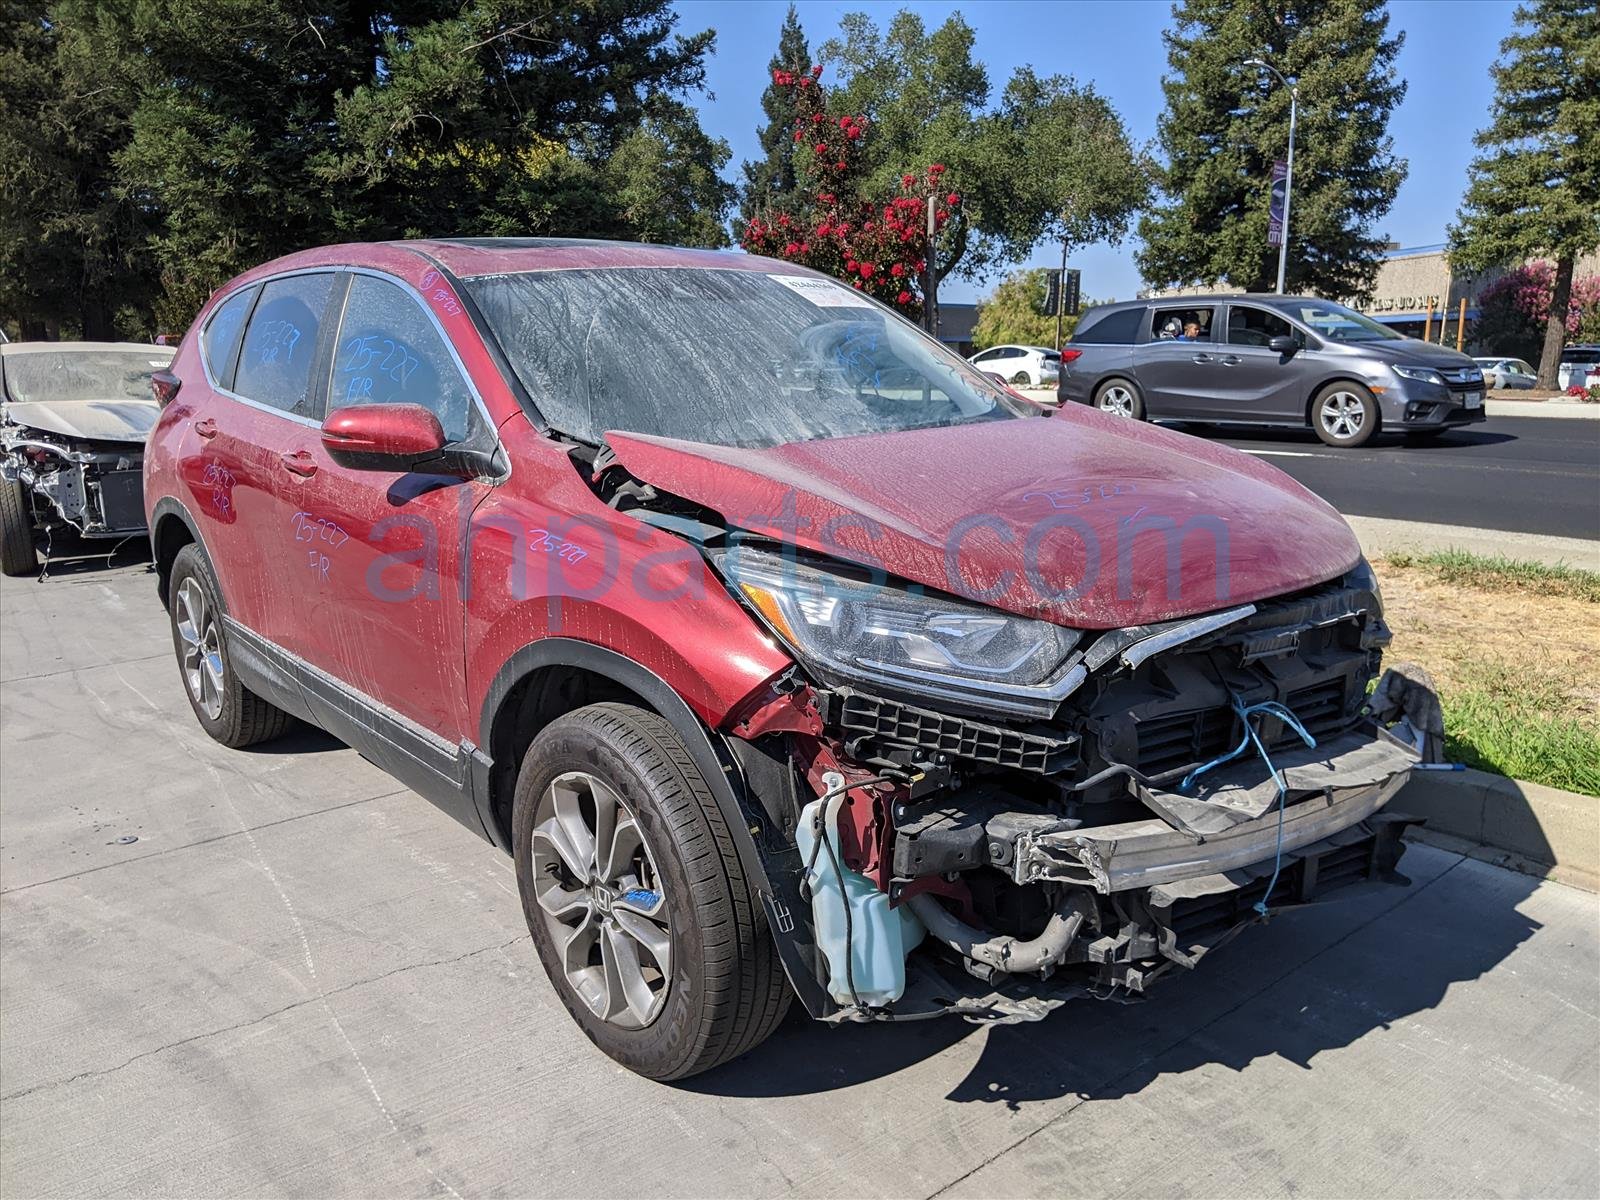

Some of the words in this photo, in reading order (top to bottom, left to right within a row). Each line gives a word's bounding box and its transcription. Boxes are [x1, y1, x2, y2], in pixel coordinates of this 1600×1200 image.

[344, 335, 419, 383] 25-227
[290, 511, 350, 550] 25-227
[529, 528, 588, 566] 25-227
